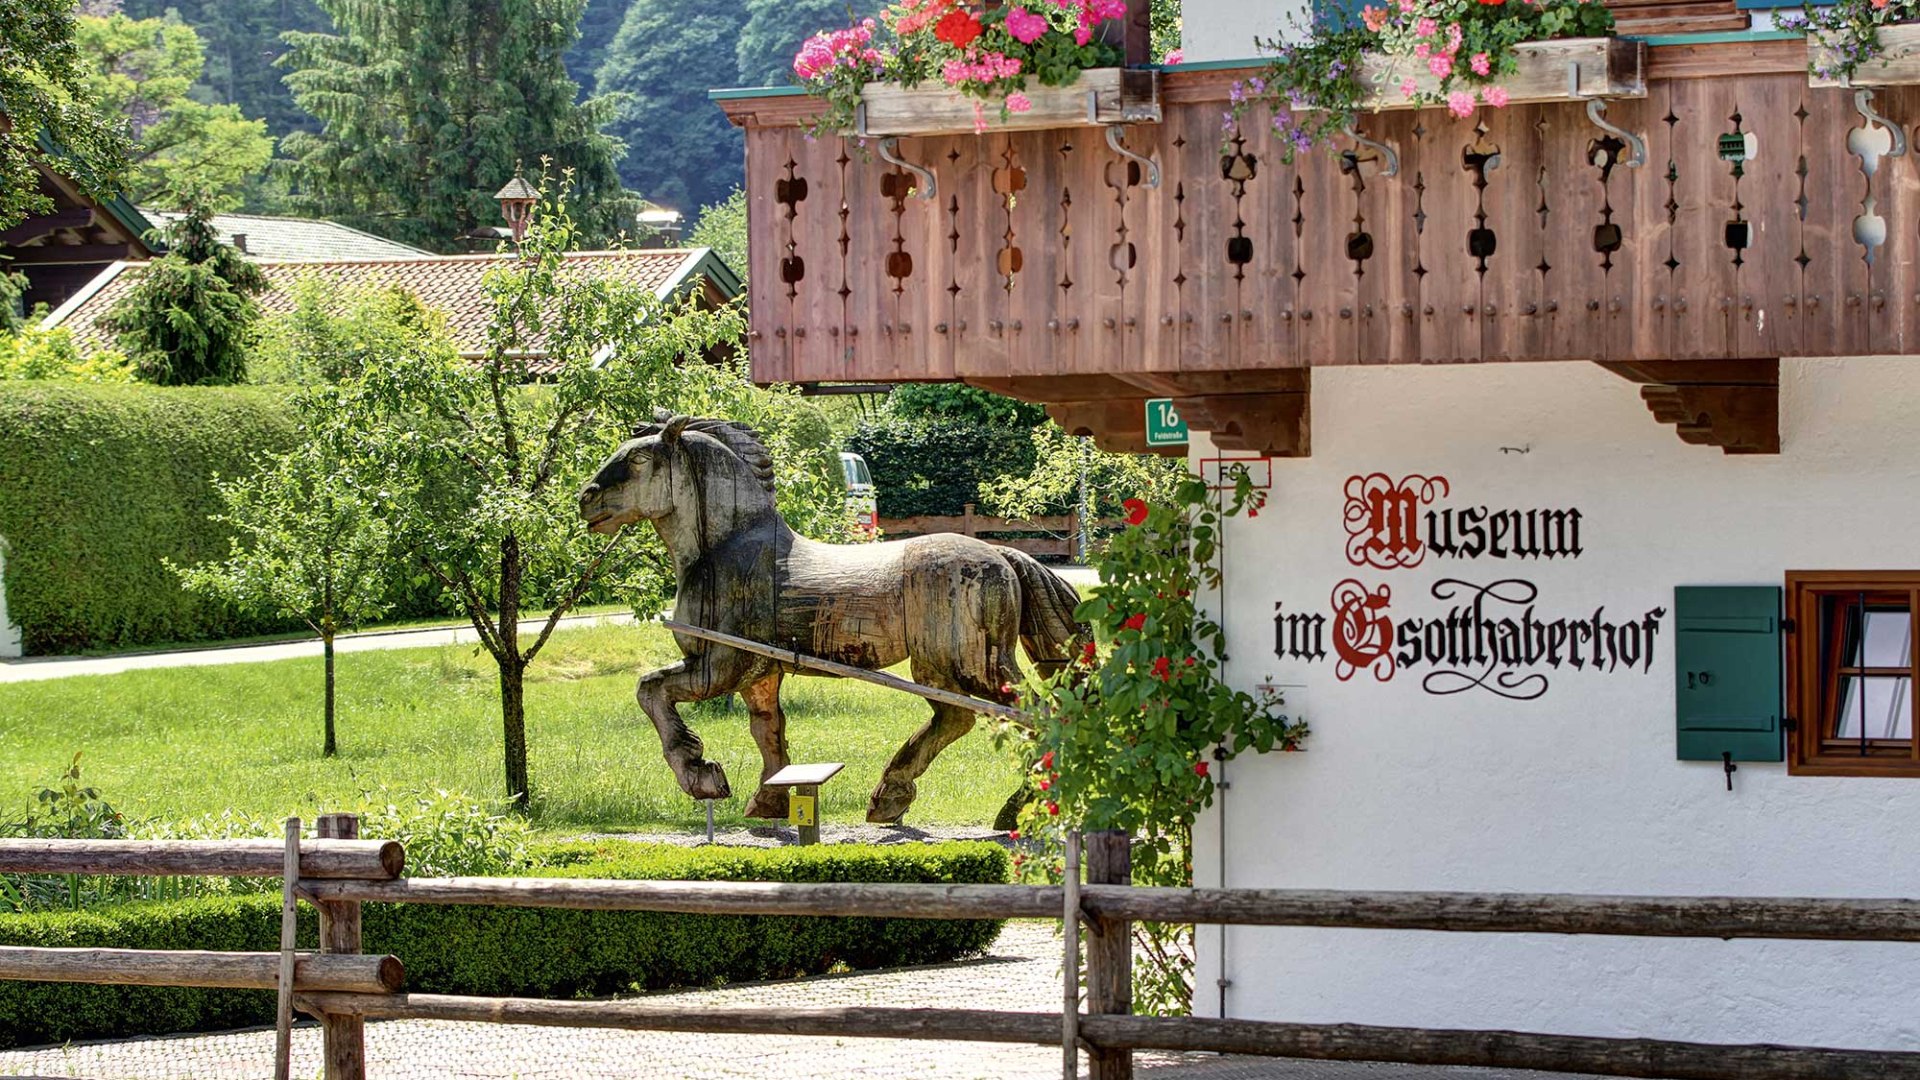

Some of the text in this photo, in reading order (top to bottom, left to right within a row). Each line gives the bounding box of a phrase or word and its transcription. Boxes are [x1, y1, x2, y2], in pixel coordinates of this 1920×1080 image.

[1158, 404, 1179, 427] 16
[1344, 473, 1583, 570] Museum
[1273, 579, 1667, 700] im Gsotthaberhof
